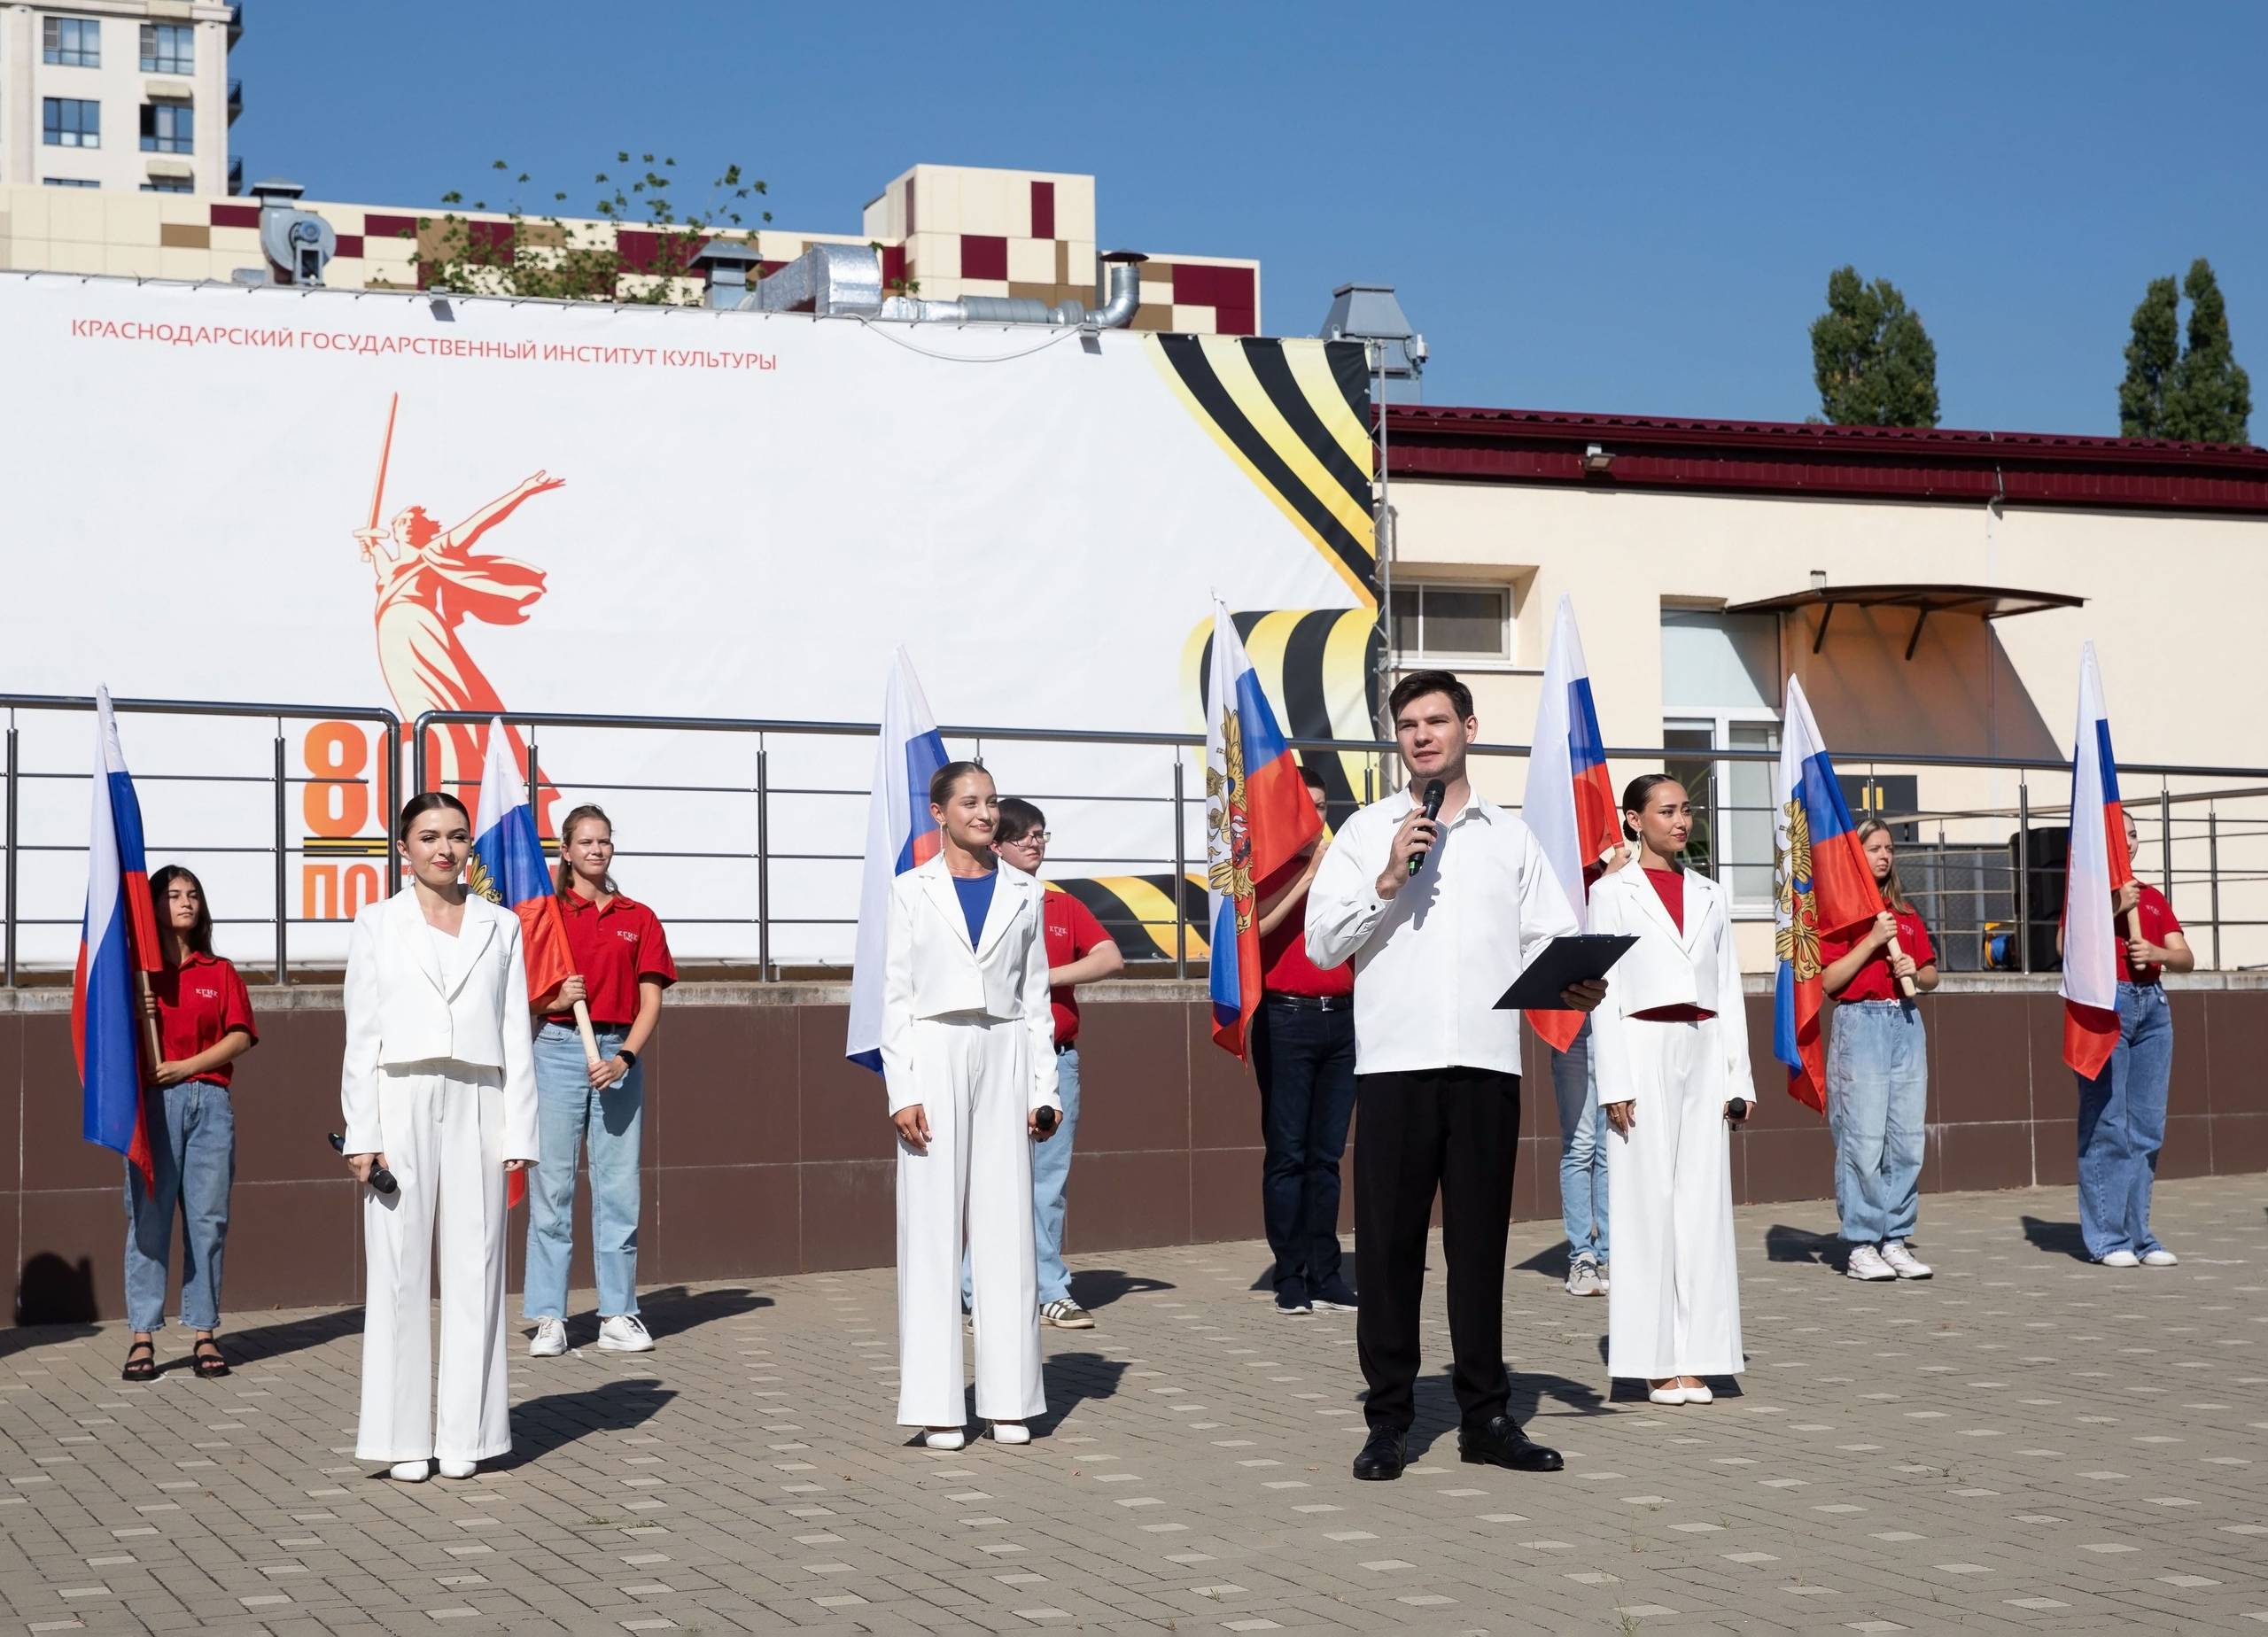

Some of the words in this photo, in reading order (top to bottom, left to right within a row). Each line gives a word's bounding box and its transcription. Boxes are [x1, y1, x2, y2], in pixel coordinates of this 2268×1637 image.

[71, 319, 294, 348] КРАСНОДАРСКИЙ
[299, 331, 537, 360] ГОСУДАРСТВЕННЫЙ
[542, 343, 657, 365] ИНСТИТУТ
[663, 350, 778, 371] КУЛЬТУРЫ
